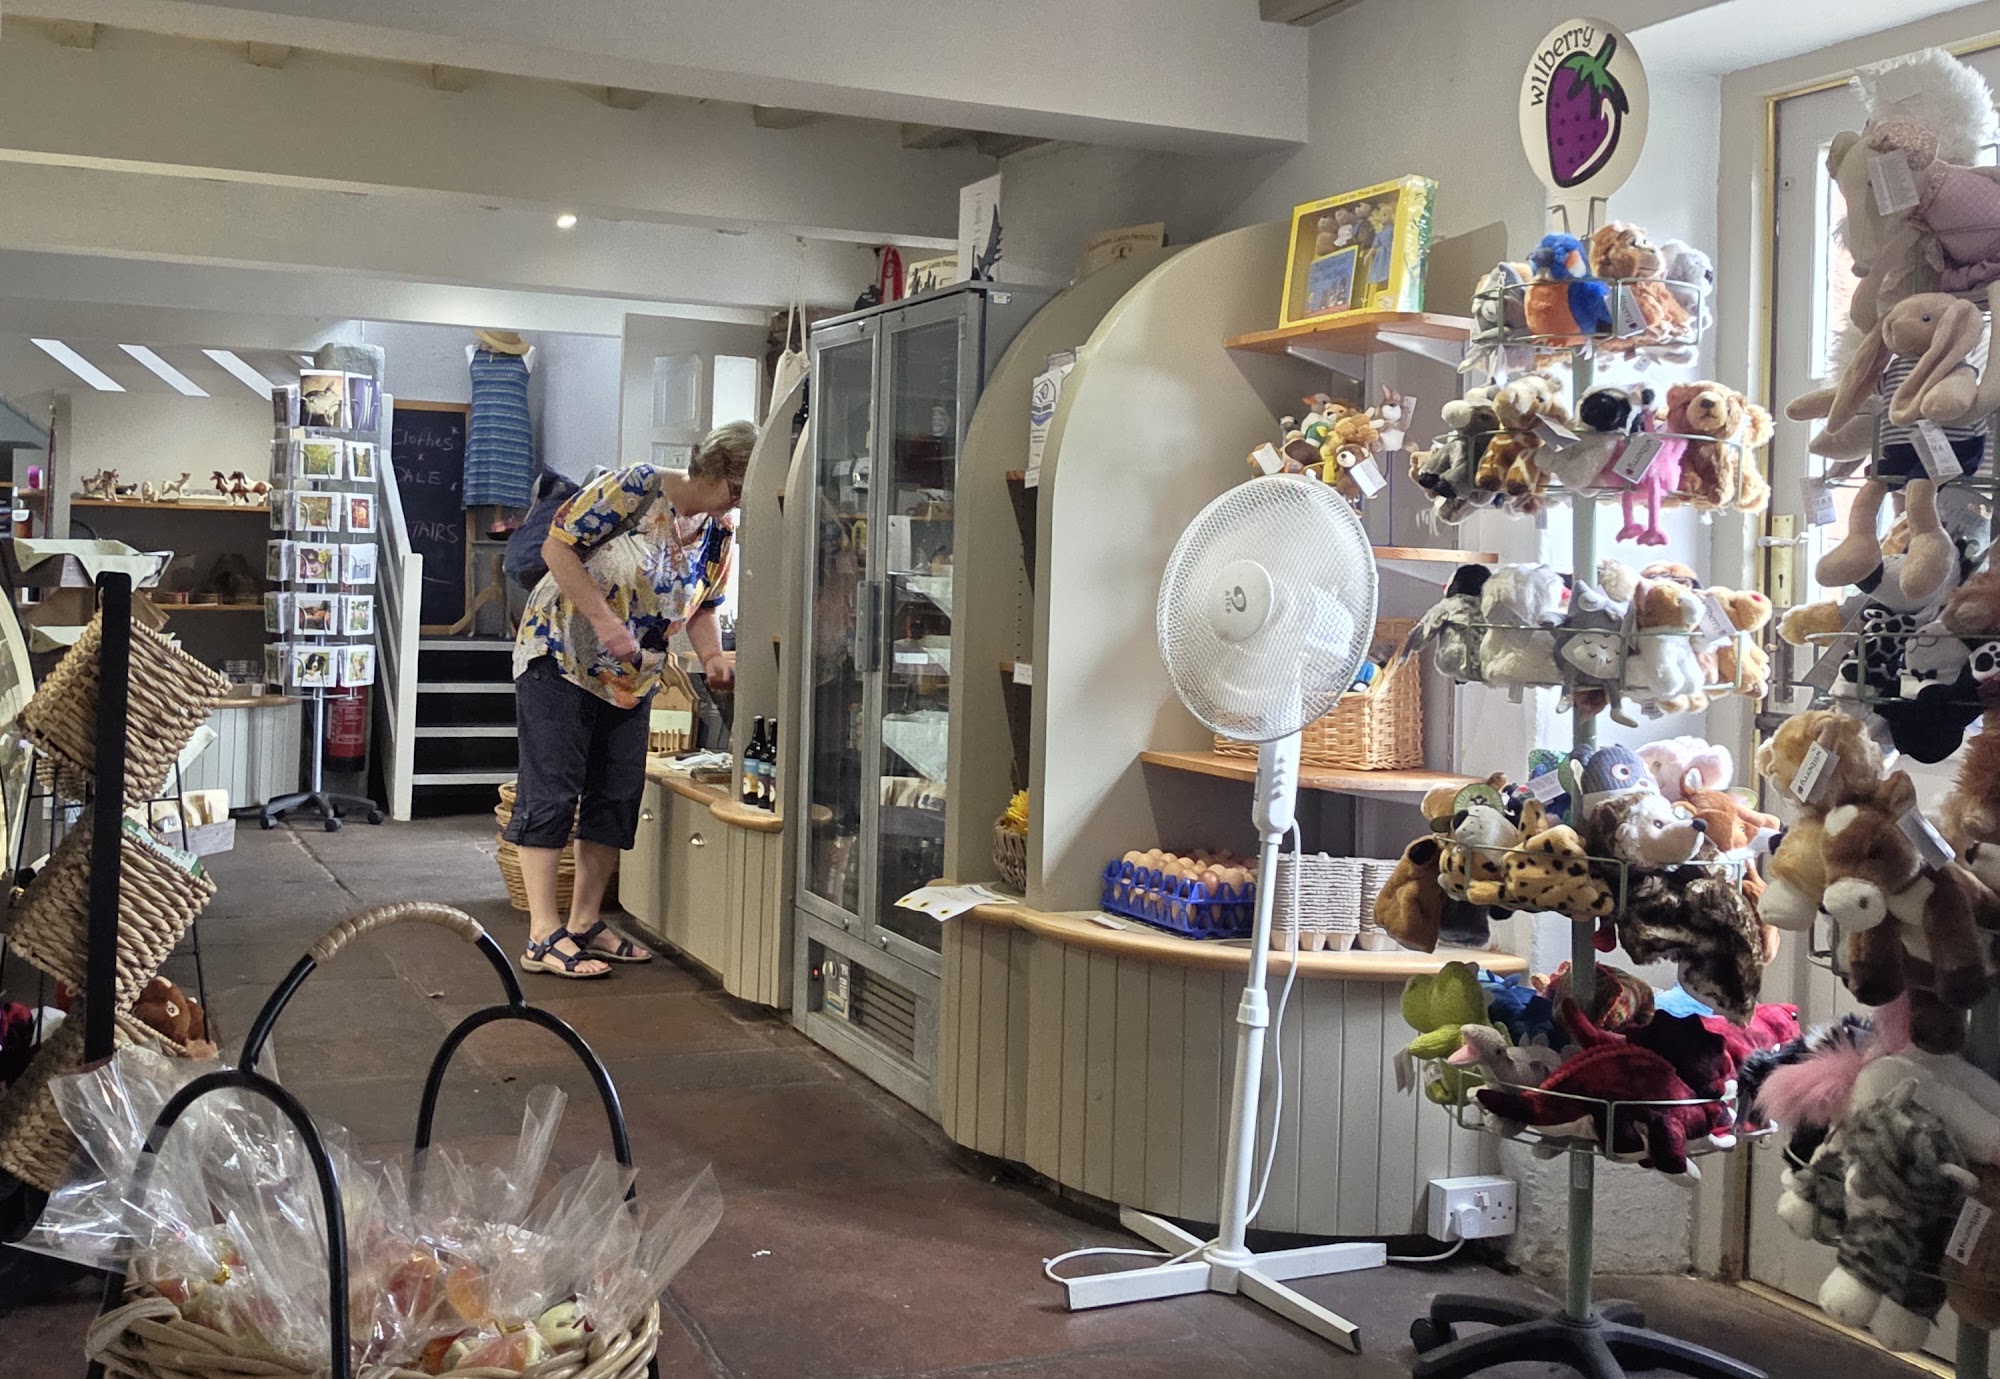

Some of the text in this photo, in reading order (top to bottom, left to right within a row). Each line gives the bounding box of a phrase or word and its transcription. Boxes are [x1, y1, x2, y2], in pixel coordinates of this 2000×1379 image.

[1531, 26, 1595, 107] wilberry
[407, 519, 459, 544] TAIRS
[1800, 750, 1822, 786] wilberry
